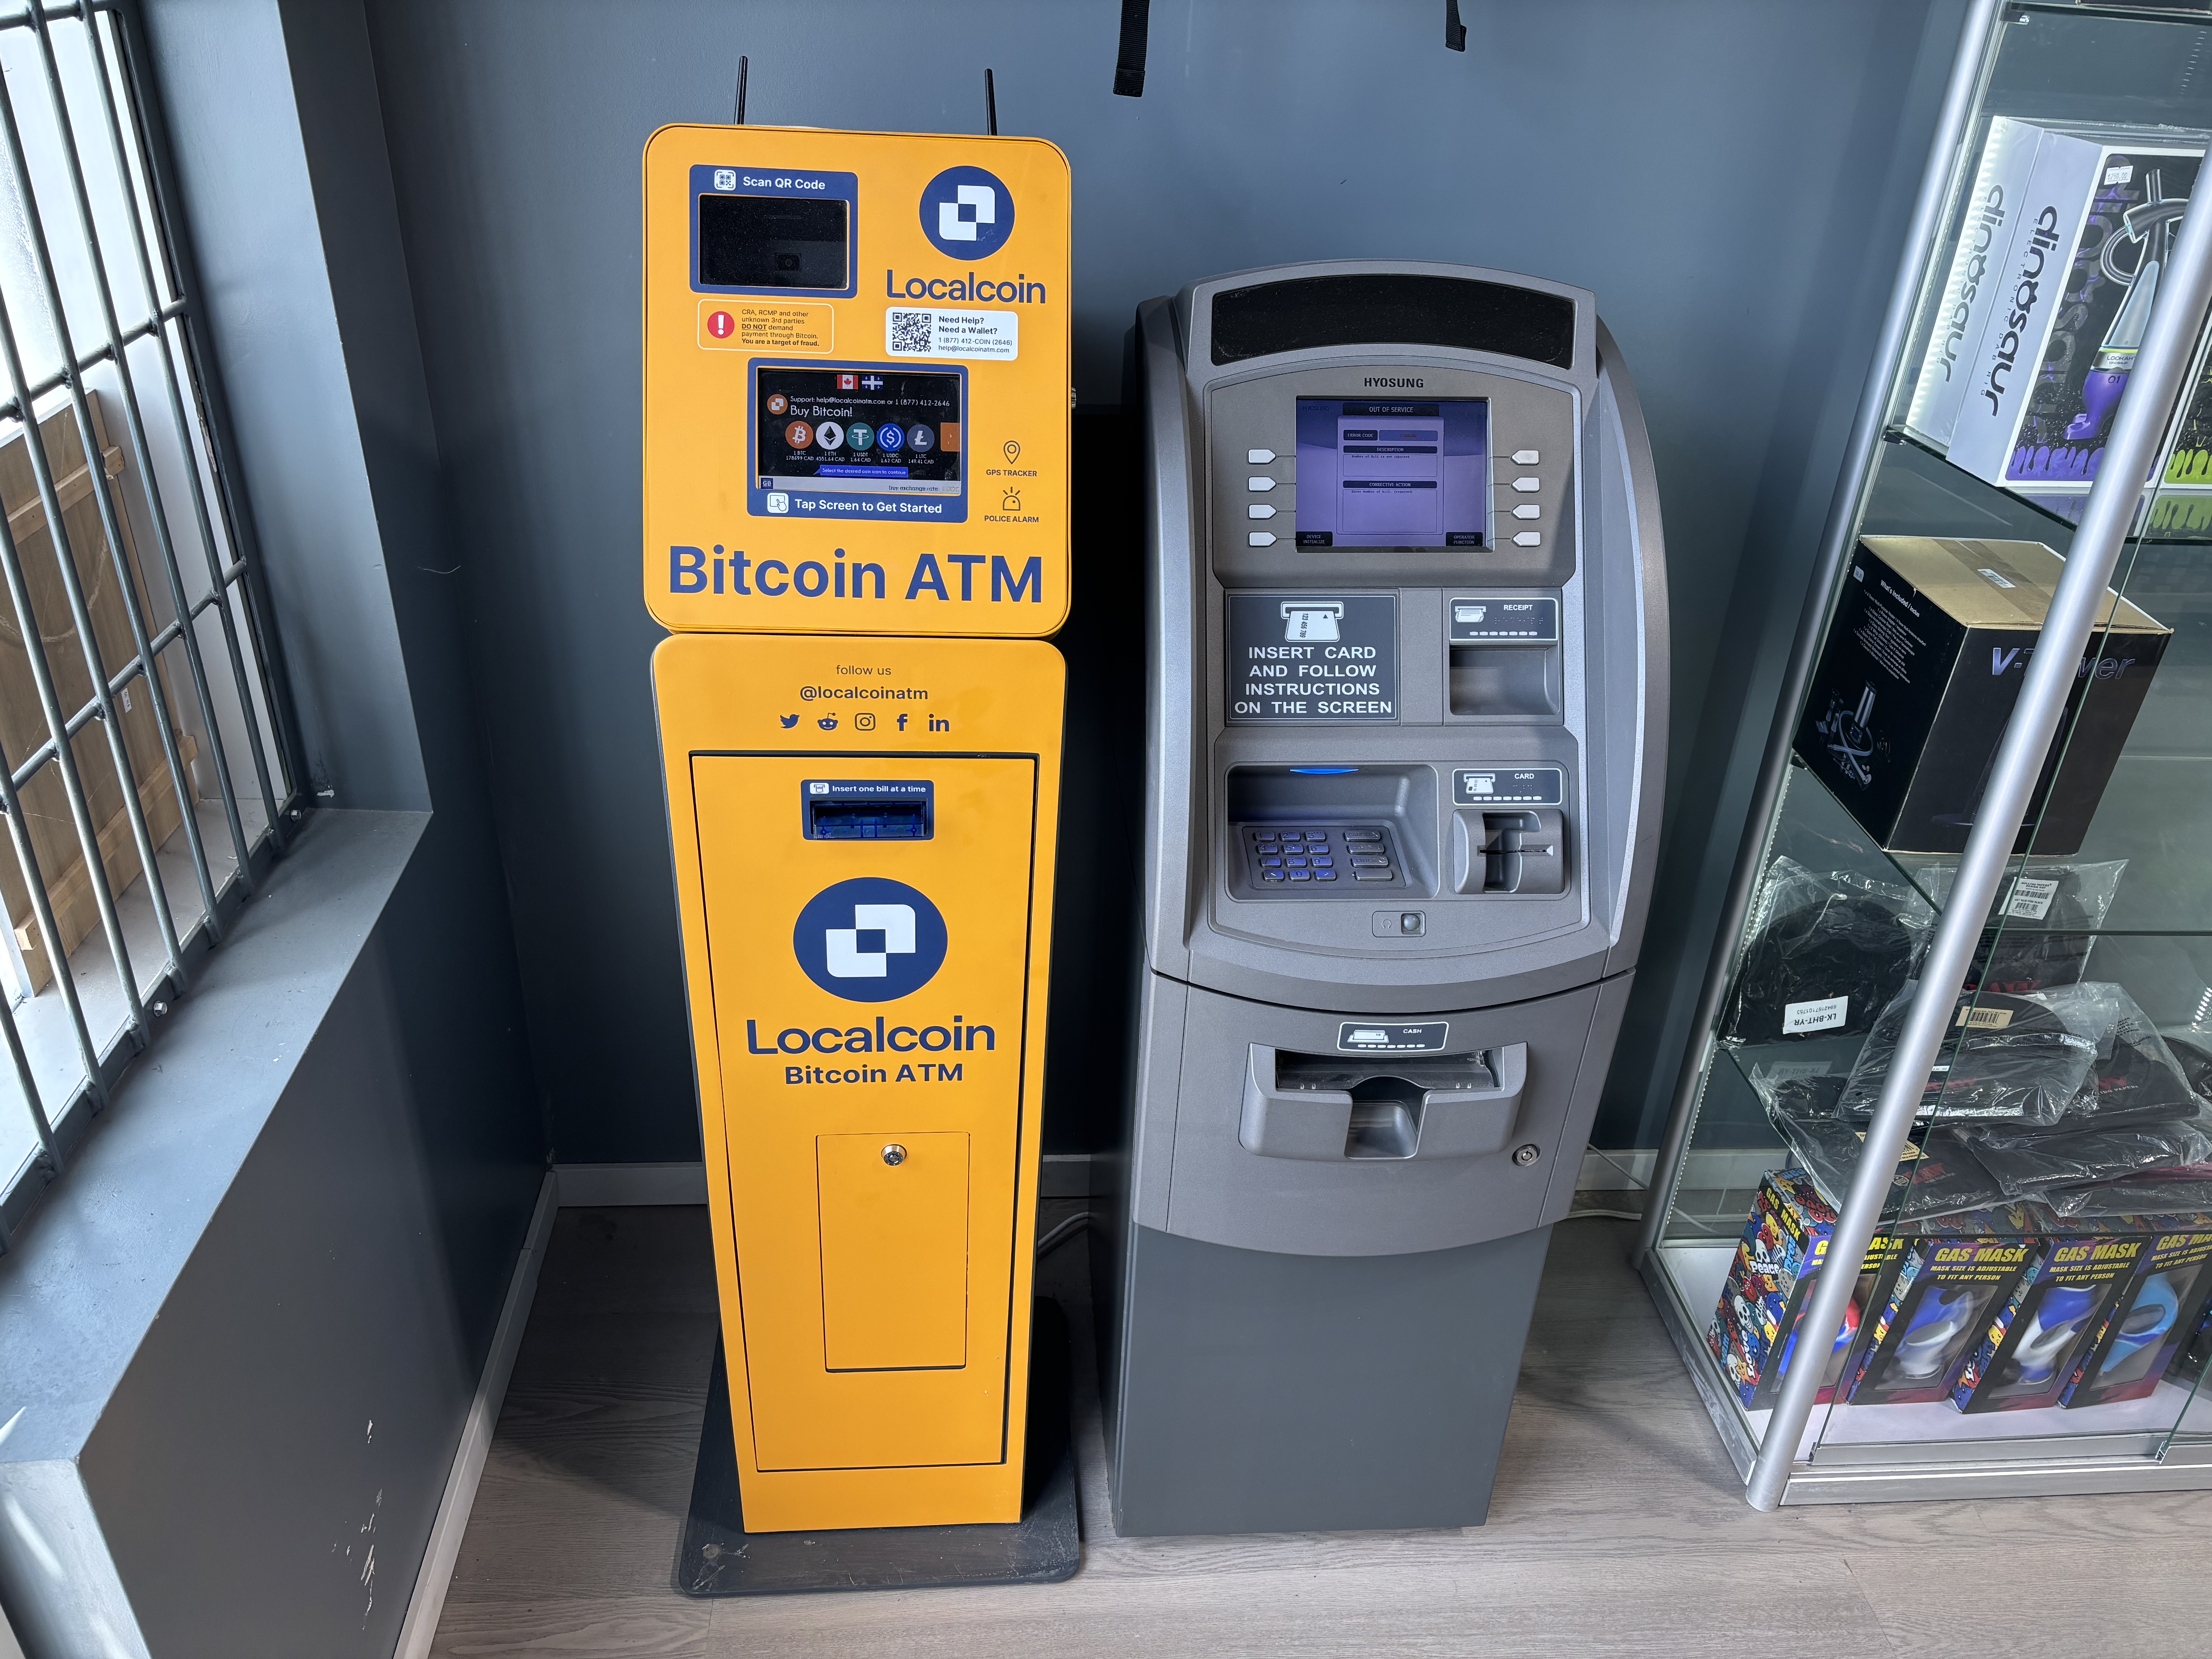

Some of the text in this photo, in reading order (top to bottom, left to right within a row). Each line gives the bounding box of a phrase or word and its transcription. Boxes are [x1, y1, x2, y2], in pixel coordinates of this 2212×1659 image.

[743, 177, 825, 190] Scan QR Code
[887, 269, 1046, 303] Localcoin
[1940, 185, 2005, 382] dinosaur
[1981, 218, 2038, 396] ELECTRONIC DAB RIG
[1985, 206, 2059, 417] dinosaur
[962, 317, 984, 325] Help?
[939, 345, 1010, 353] help@localcoinatm.com
[1364, 378, 1424, 388] HYOSUNG
[2108, 375, 2121, 384] 01
[790, 405, 852, 417] Buy Bitcoin!
[795, 499, 942, 514] Tap Screen to Get Started
[670, 544, 1042, 603] Bitcoin ATM
[1892, 590, 1908, 608] Included
[1249, 647, 1376, 659] INSERT CARD
[836, 665, 891, 676] follow us
[1249, 665, 1376, 677] AND FOLLOW
[800, 685, 928, 702] @localcoinatm
[1245, 683, 1379, 696] INSTRUCTIONS
[1235, 701, 1391, 714] ON THE SCREEN
[1794, 1013, 1836, 1025] LK-BHT-YR
[747, 1015, 995, 1054] Localcoin
[785, 1063, 963, 1084] Bitcoin ATM
[1766, 1187, 1780, 1210] GAS
[1781, 1209, 1801, 1241] MASK
[2156, 1234, 2212, 1250] GAS MA
[1935, 1248, 2029, 1262] GAS MASK
[2054, 1243, 2142, 1262] GAS MASK
[2186, 1254, 2208, 1262] PERSON
